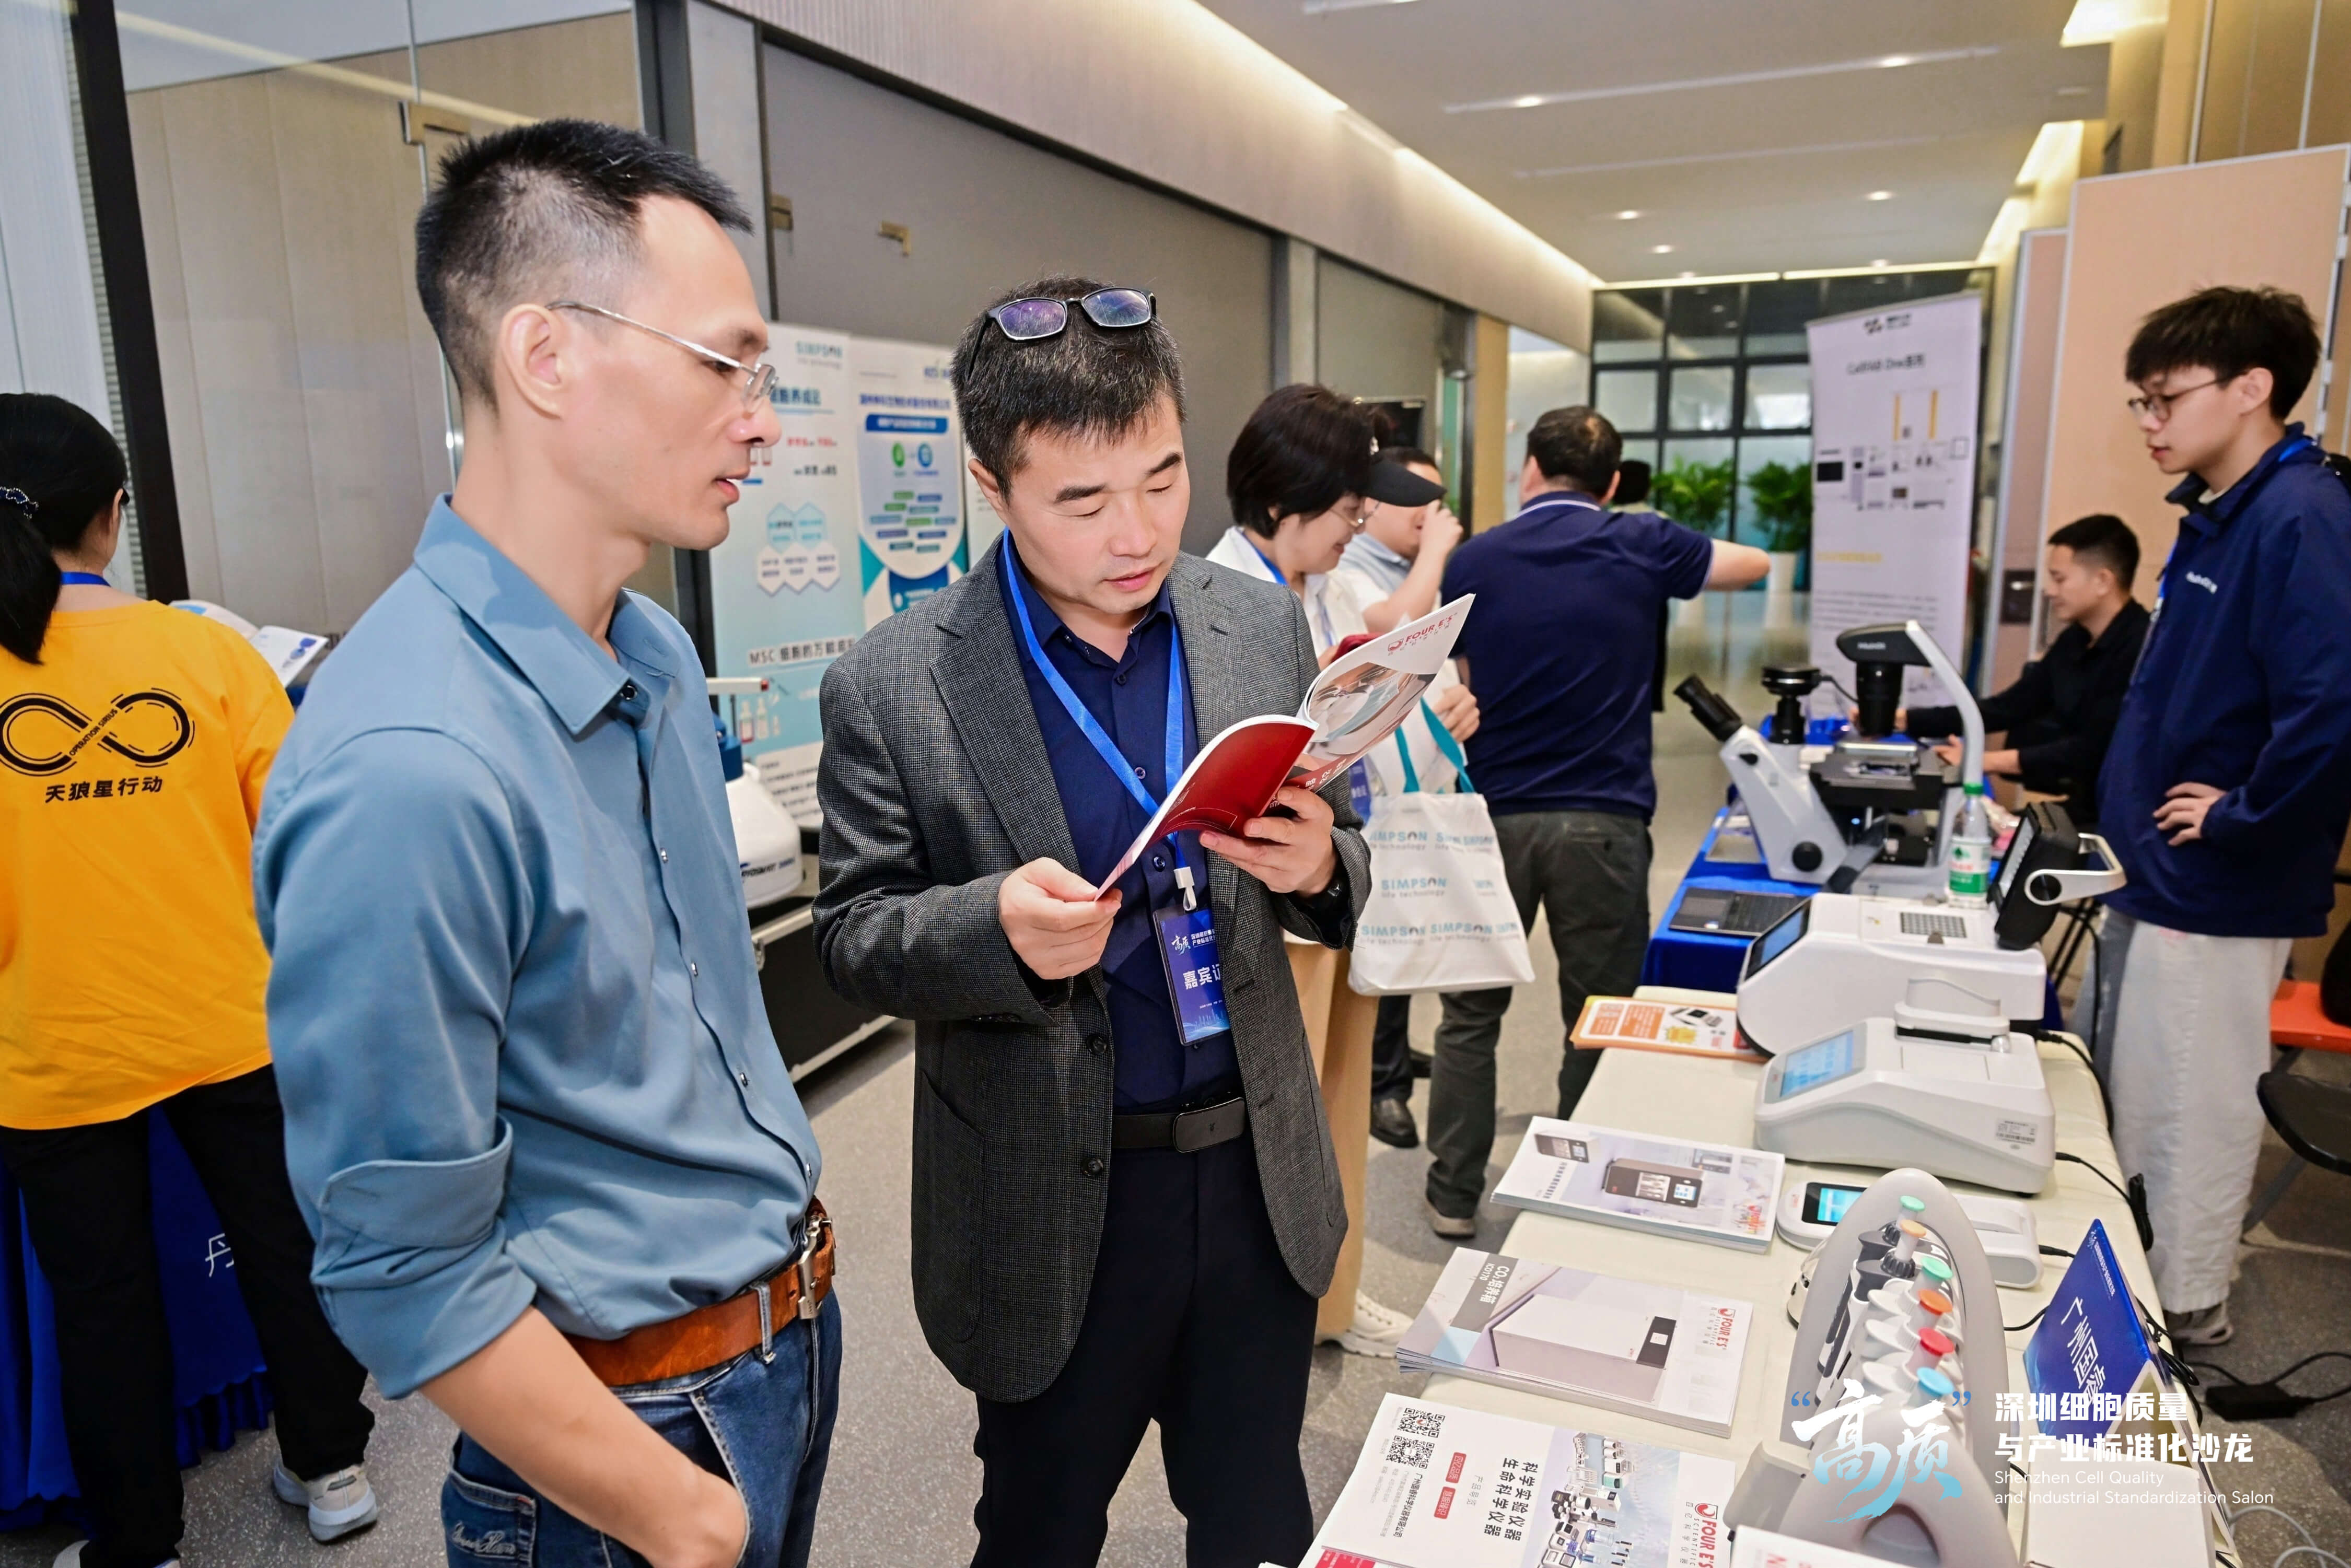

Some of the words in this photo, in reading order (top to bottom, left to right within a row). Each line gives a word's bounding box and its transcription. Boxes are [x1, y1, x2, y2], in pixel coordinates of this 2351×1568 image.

[1405, 624, 1435, 642] FOUR
[1438, 615, 1453, 627] E'S
[750, 650, 774, 664] MSC
[69, 726, 101, 756] OPERATION
[98, 708, 118, 728] SIRIUS
[45, 776, 163, 803] 天狼星行动
[1381, 877, 1447, 890] SIMPSON
[1400, 889, 1446, 898] technology
[1361, 925, 1426, 937] SIMPSON
[1430, 922, 1493, 934] SIMPSON
[1479, 1262, 1496, 1281] ICO170
[1719, 1317, 1733, 1337] FOUR
[1716, 1337, 1729, 1348] E'S
[1484, 1457, 1519, 1537] 生命科学仪器
[1504, 1462, 1539, 1541] 科学实验仪器
[1689, 1517, 1700, 1566] SCIENTIFIC
[1700, 1519, 1717, 1551] FOUR
[1698, 1552, 1715, 1568] E'S
